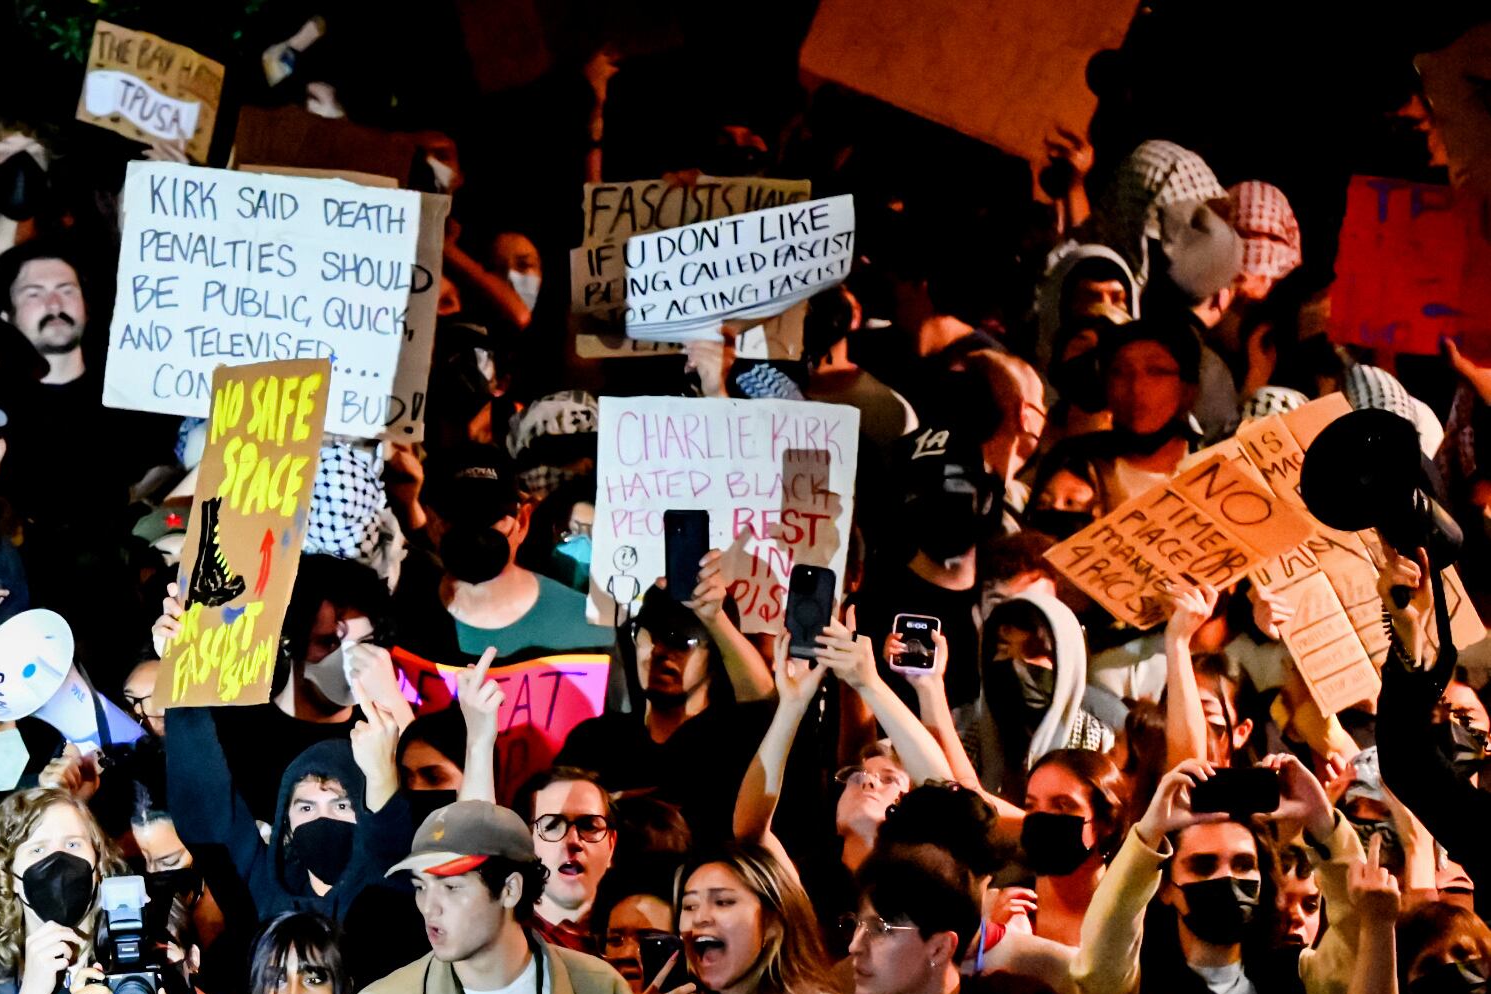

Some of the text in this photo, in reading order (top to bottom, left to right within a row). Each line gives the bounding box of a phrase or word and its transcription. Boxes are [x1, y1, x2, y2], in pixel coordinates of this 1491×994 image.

[119, 79, 180, 133] TPUSA
[150, 174, 405, 234] KIRK SAID DEATH
[588, 183, 736, 238] FASCISTS
[139, 228, 434, 294] PENALTIES SHOULD
[586, 246, 613, 277] IF
[657, 219, 745, 264] DON'T
[759, 203, 830, 245] LIKE
[679, 231, 853, 287] CALLED FASCIST
[131, 275, 414, 342] BE PUBLIC, QUICK,
[665, 283, 760, 321] ACTING
[768, 256, 850, 298] FASCIST
[118, 320, 173, 352] AND
[210, 372, 323, 447] NO SAFE
[339, 389, 424, 434] BUD!
[616, 411, 844, 467] CHARLIE KIRK
[910, 427, 950, 460] LA
[217, 435, 311, 518] SPACE
[605, 469, 833, 510] HATED BLACK
[1187, 461, 1273, 526] NO
[732, 507, 831, 547] REST
[1149, 489, 1229, 553] TIME
[750, 546, 794, 579] IN
